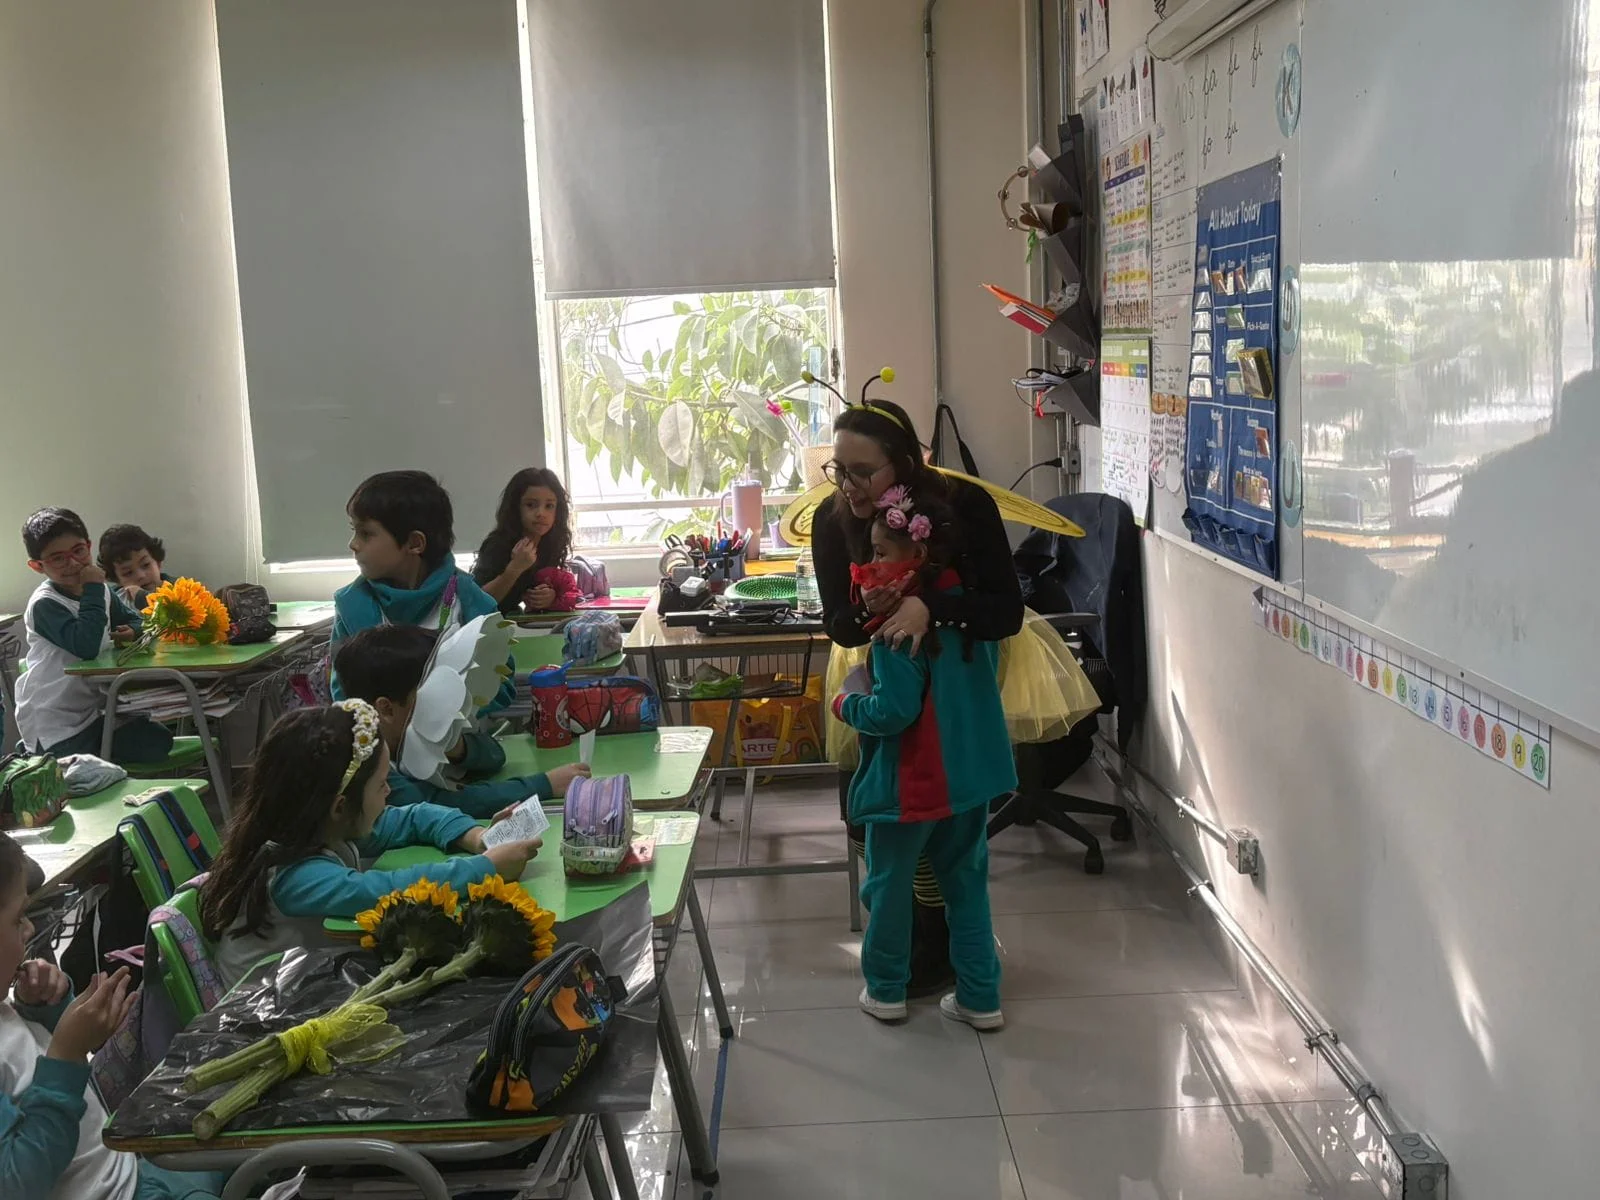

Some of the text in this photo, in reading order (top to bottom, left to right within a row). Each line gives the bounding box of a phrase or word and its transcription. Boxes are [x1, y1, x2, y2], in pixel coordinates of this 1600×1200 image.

[1281, 62, 1295, 119] K
[1207, 208, 1219, 232] All
[1219, 204, 1239, 229] About
[1240, 199, 1261, 226] Today
[1532, 753, 1544, 774] 20
